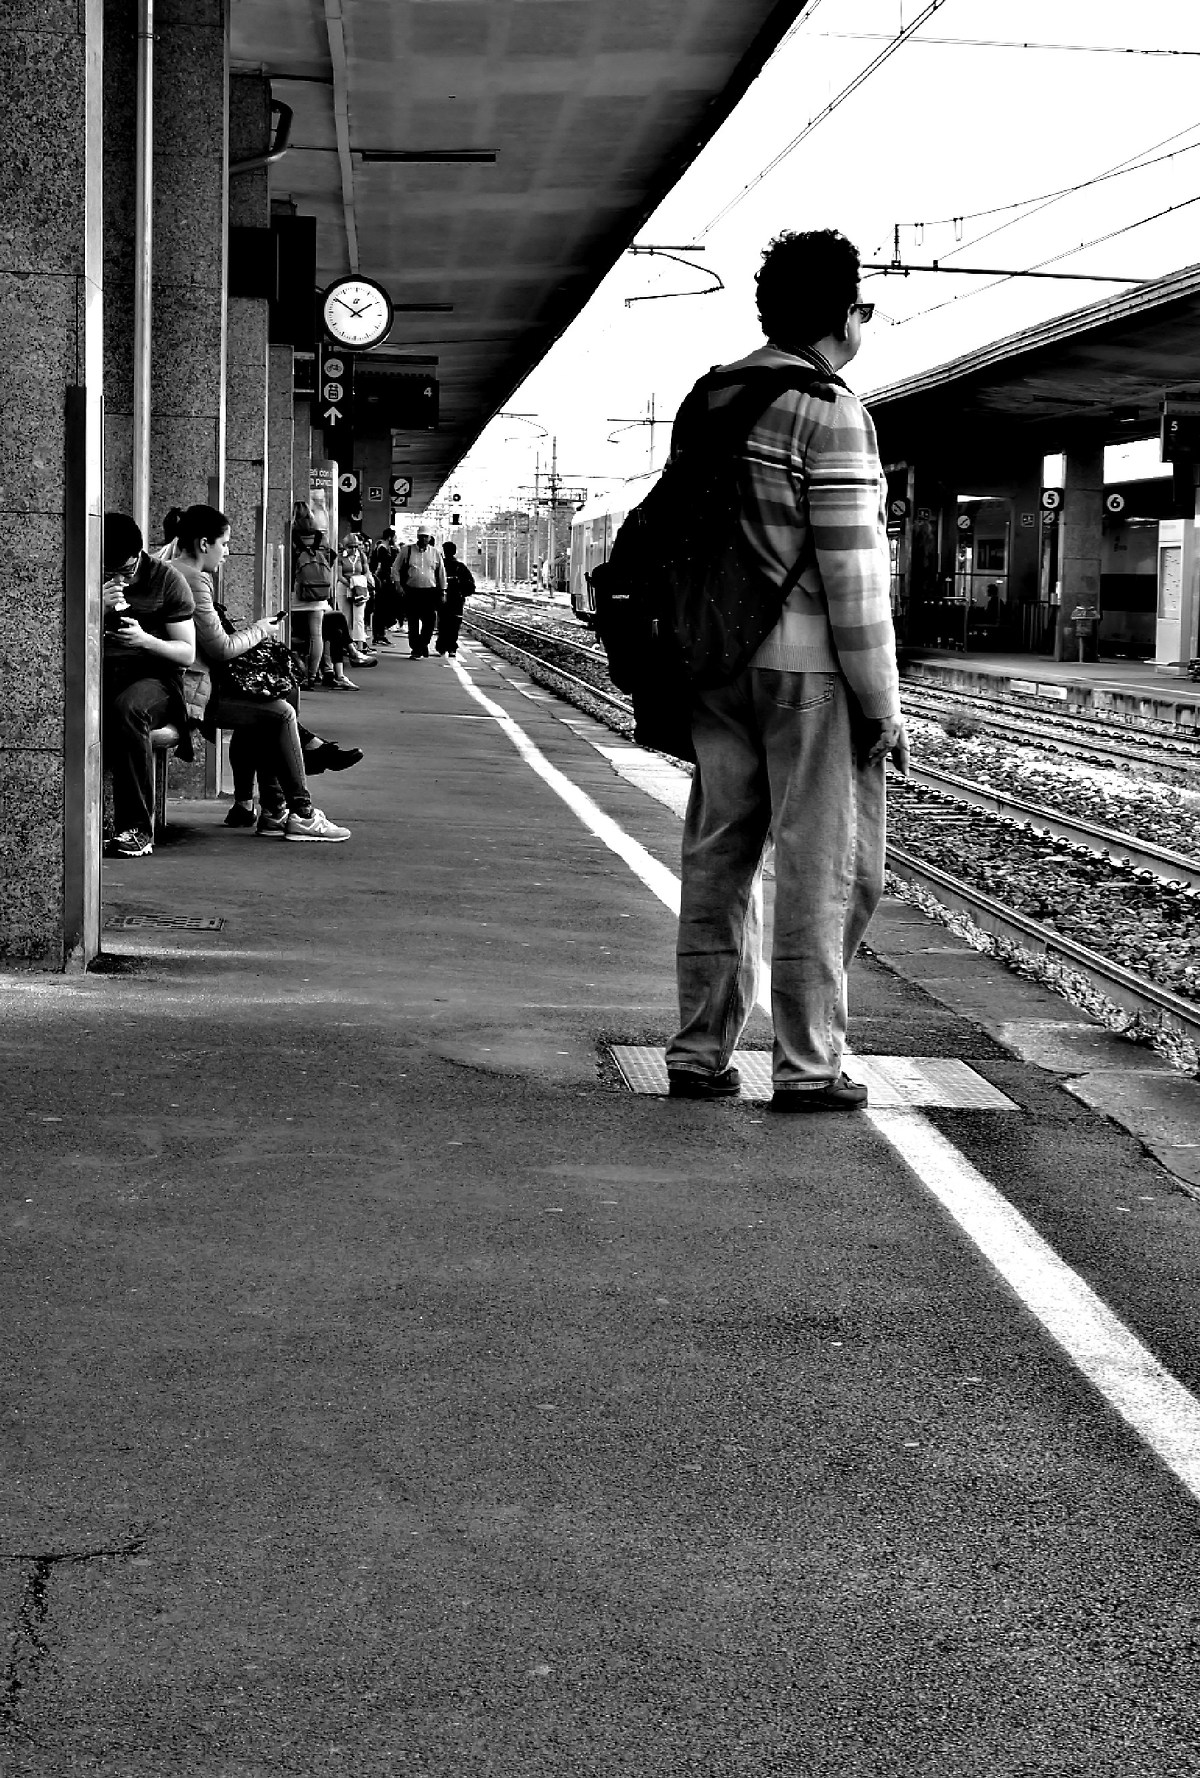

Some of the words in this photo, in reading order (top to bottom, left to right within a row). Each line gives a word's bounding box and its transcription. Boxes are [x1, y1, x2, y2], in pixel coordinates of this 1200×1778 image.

[424, 388, 432, 397] 4
[1171, 421, 1178, 431] 5
[341, 476, 352, 489] 4
[1047, 493, 1056, 506] 5
[1110, 496, 1120, 508] 6
